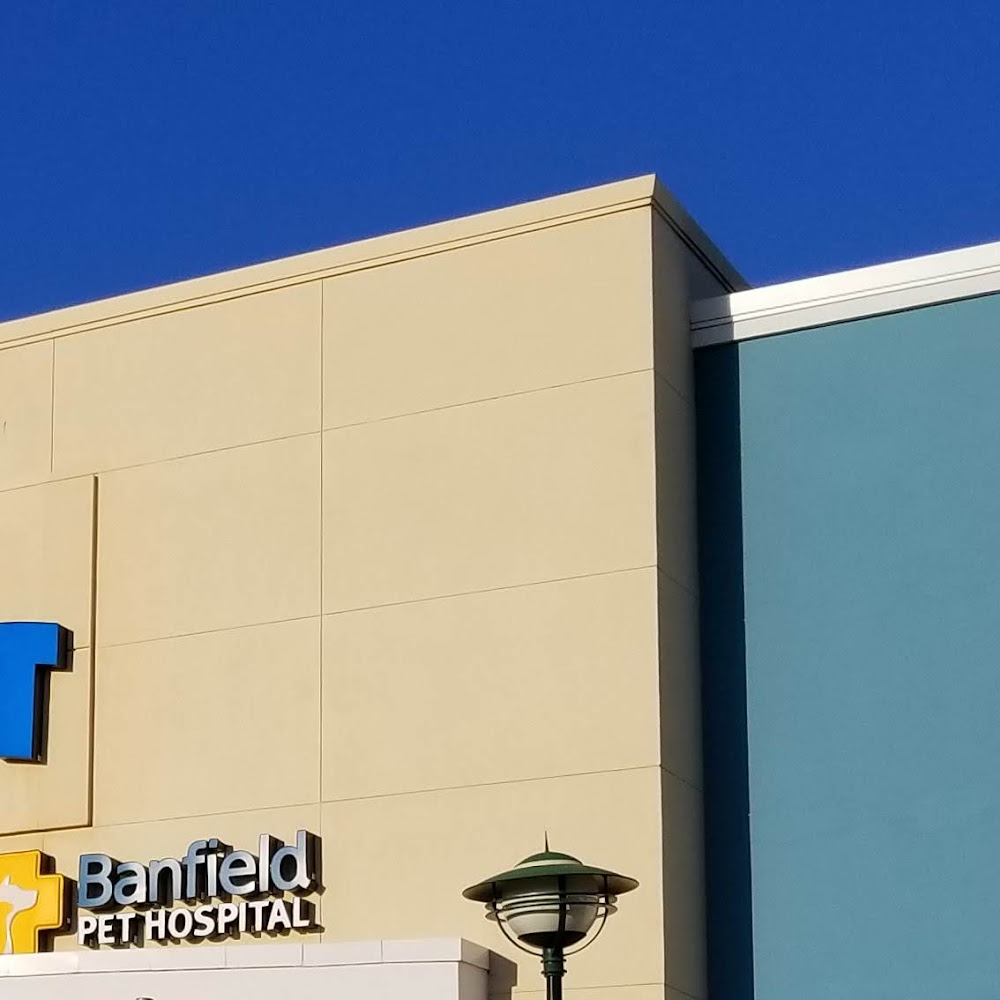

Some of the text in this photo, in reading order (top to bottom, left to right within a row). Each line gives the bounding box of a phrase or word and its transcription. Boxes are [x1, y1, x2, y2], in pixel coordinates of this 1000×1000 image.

[78, 830, 313, 909] Banfield
[78, 897, 312, 946] PET HOSPITAL
